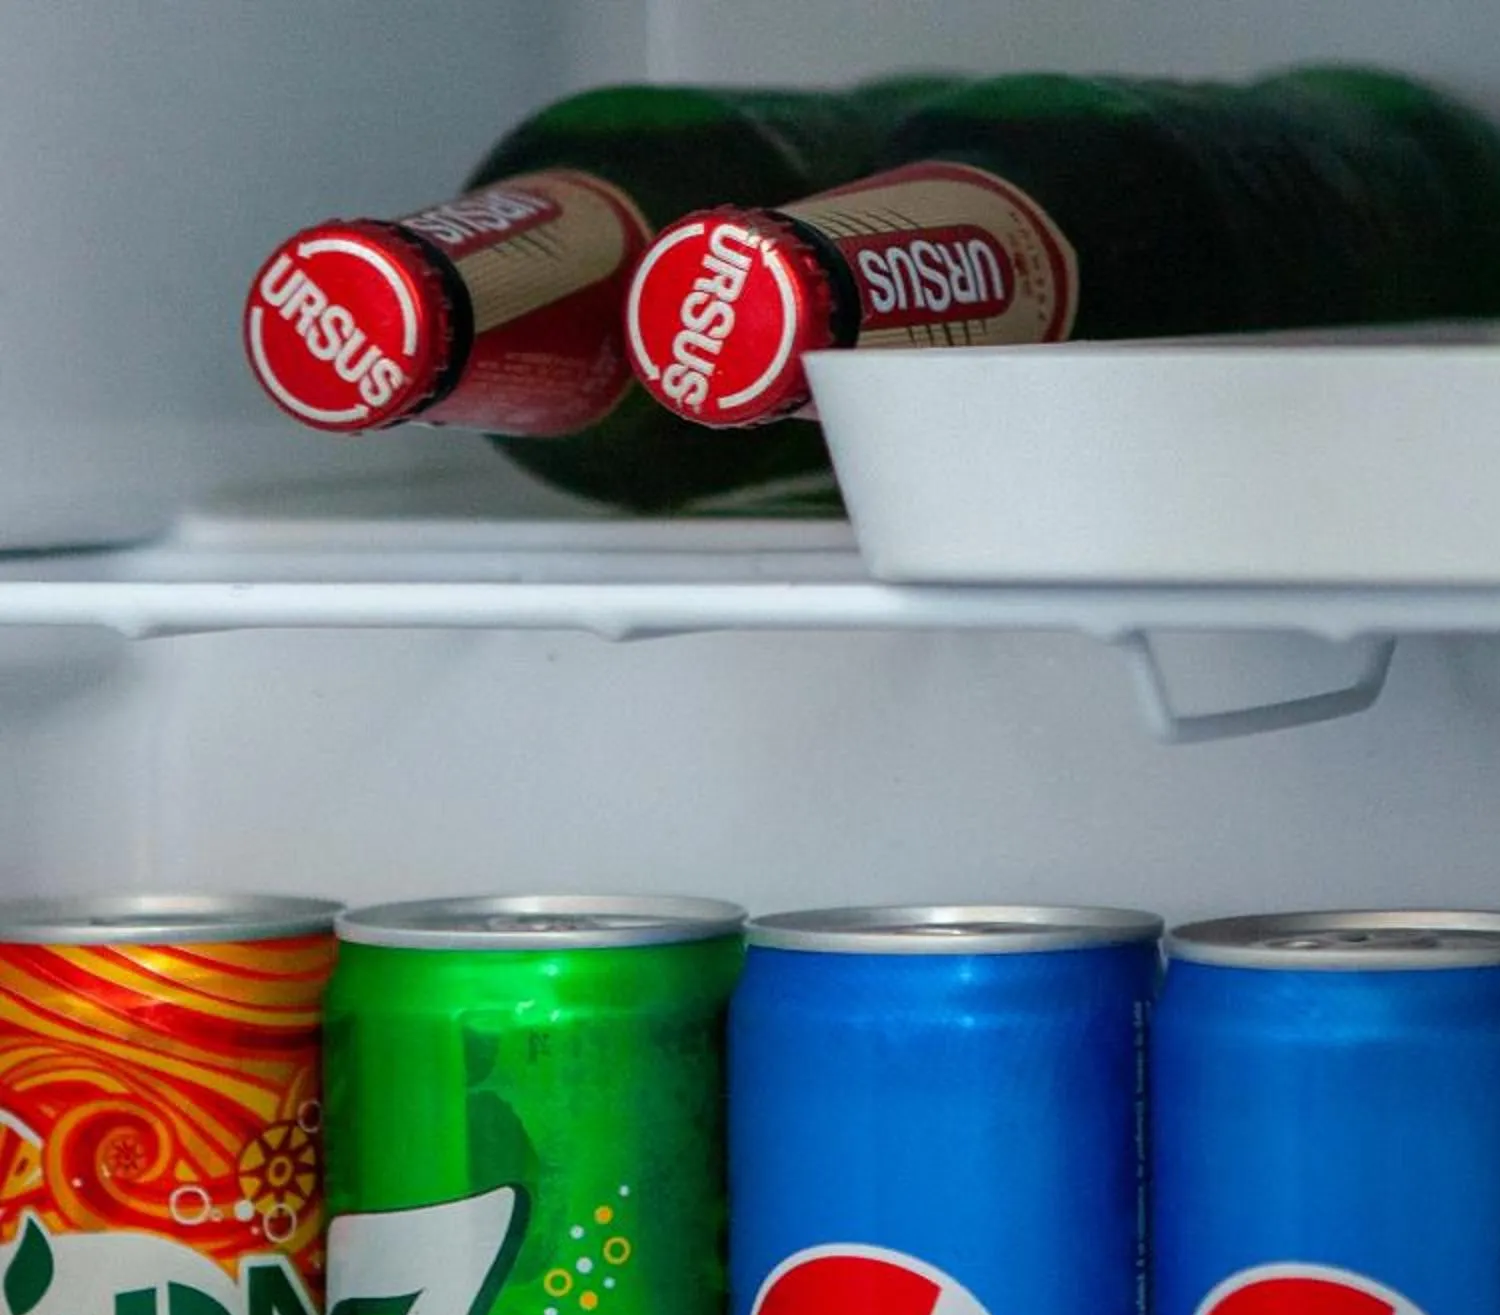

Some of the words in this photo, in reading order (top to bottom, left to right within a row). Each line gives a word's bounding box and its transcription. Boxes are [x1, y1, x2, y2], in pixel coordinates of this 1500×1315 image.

[257, 254, 404, 412] URSUS
[661, 222, 756, 411] URSUS
[857, 238, 1006, 314] URSUS
